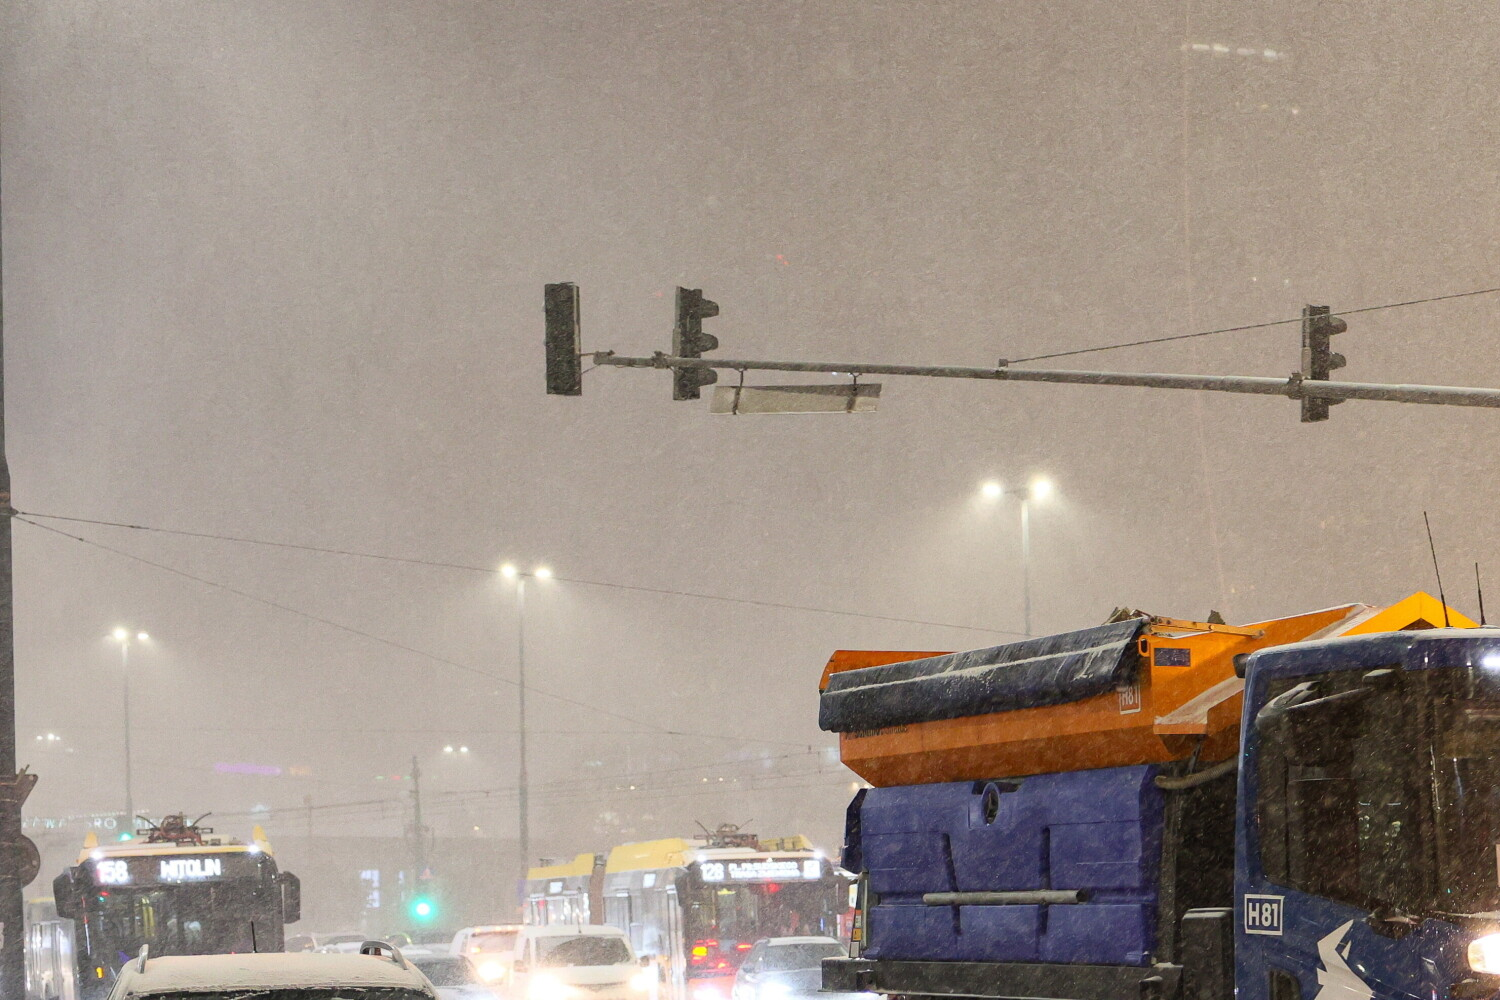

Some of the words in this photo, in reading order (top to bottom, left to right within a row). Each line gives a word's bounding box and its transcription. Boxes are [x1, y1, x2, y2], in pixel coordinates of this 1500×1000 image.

[97, 860, 129, 882] 158
[160, 858, 221, 878] WITOLIN
[700, 863, 724, 881] 128
[1248, 902, 1279, 927] H81
